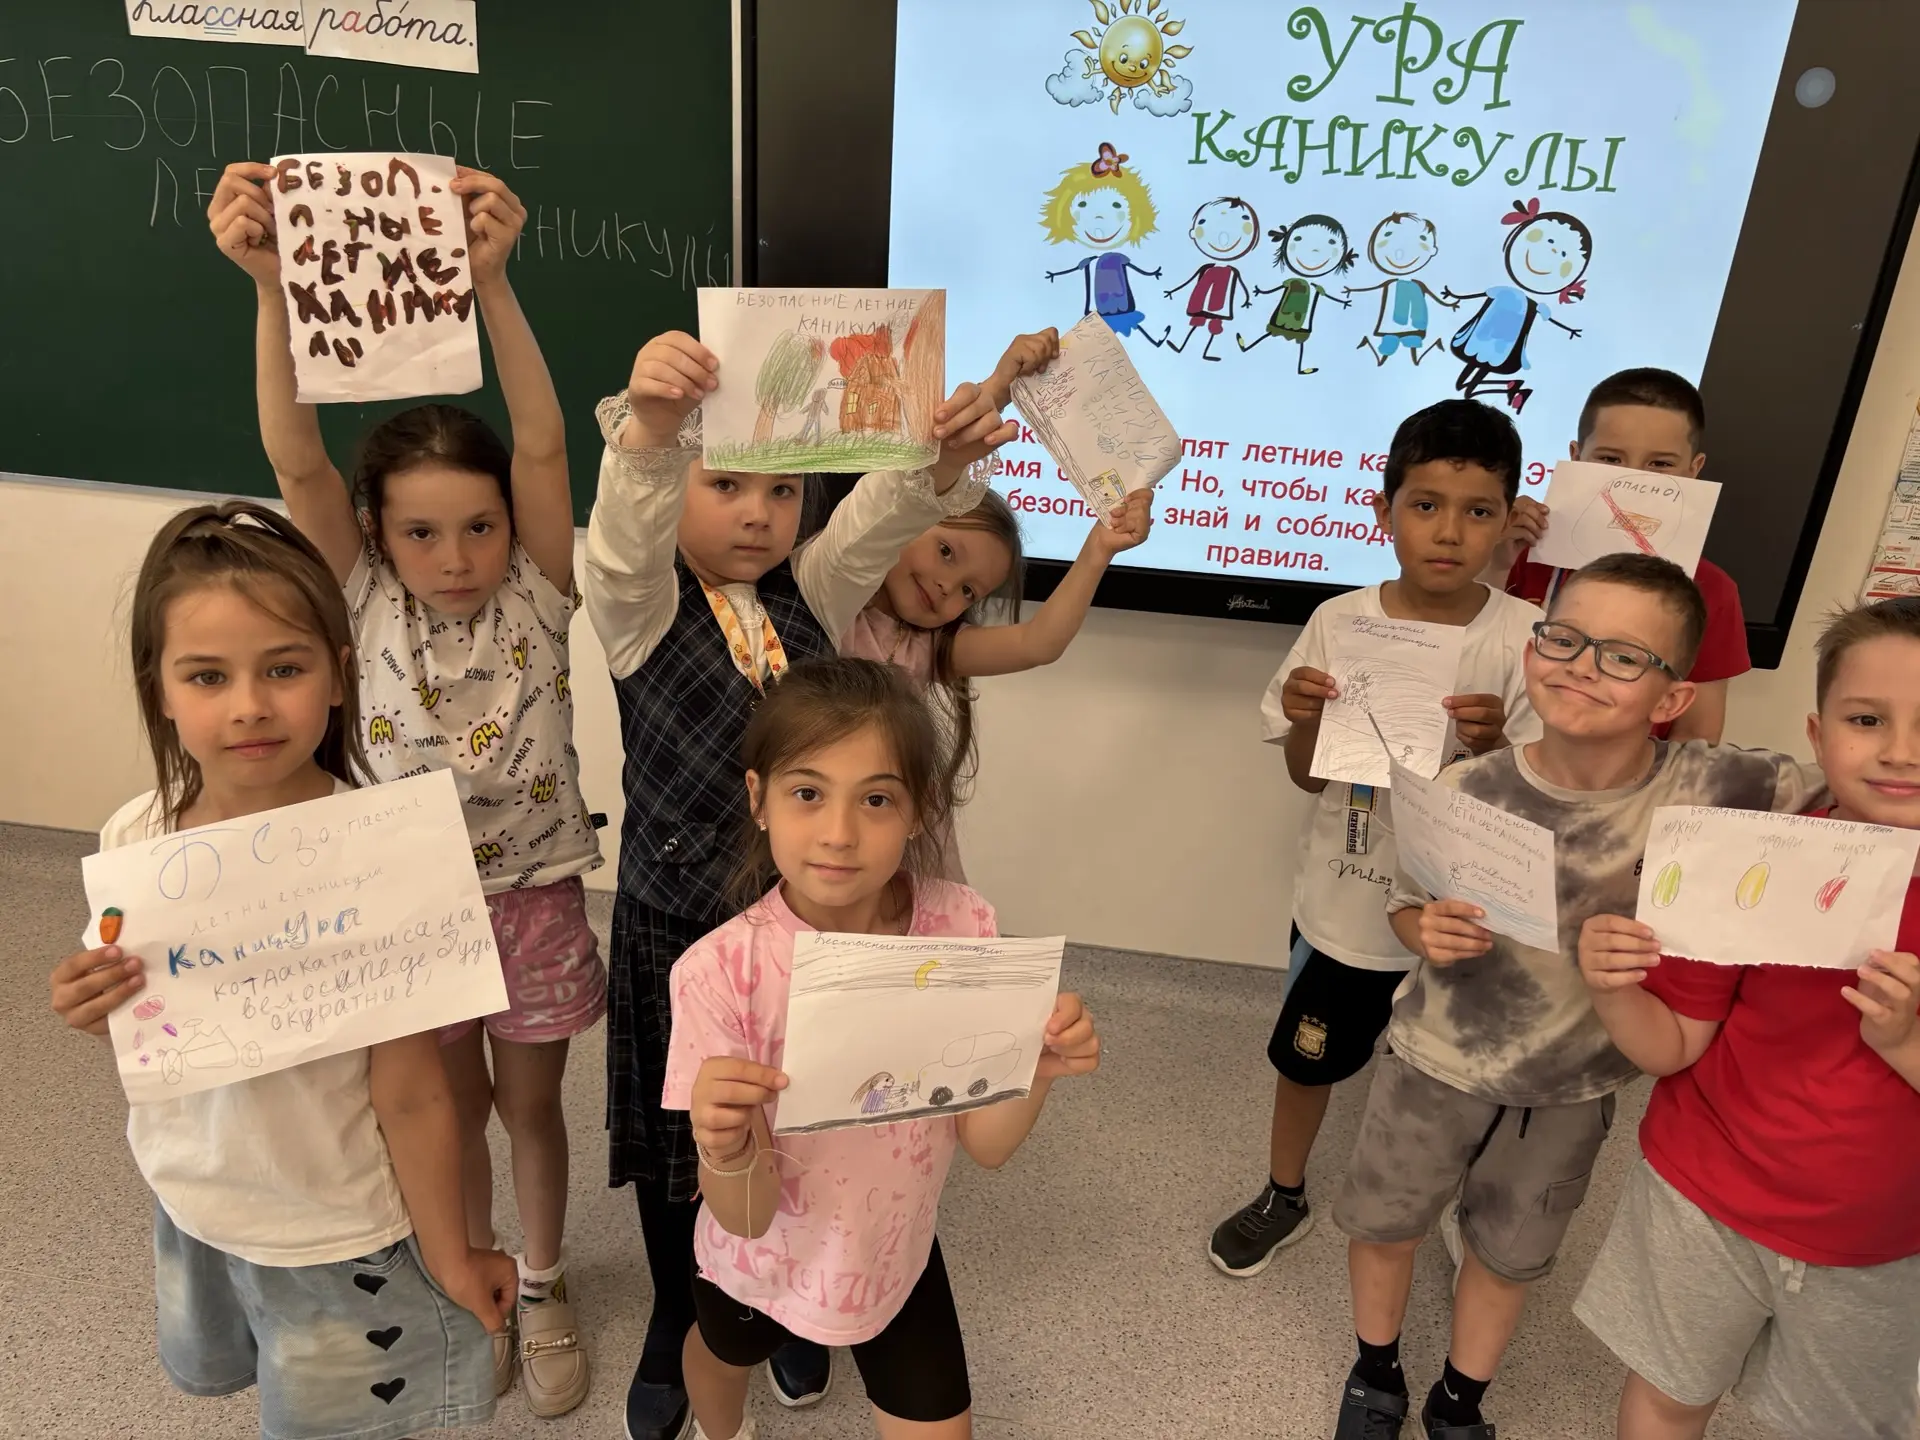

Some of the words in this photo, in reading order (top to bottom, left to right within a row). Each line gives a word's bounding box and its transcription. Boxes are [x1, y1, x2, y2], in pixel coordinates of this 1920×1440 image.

[1287, 2, 1525, 111] УРА
[1188, 109, 1627, 193] КАНИКУЛЫ
[736, 292, 848, 310] БЕЗОПАСНЫЕ
[853, 298, 917, 312] ЛЕТНИЕ
[1242, 443, 1343, 468] летние
[1181, 469, 1224, 498] Но,
[1242, 477, 1328, 502] чтобы
[1164, 505, 1229, 529] знай
[1244, 513, 1262, 532] и
[1206, 544, 1330, 572] правила.
[415, 735, 450, 749] БУМАГА
[506, 736, 536, 779] БУМАГА
[528, 817, 567, 850] БУМАГА
